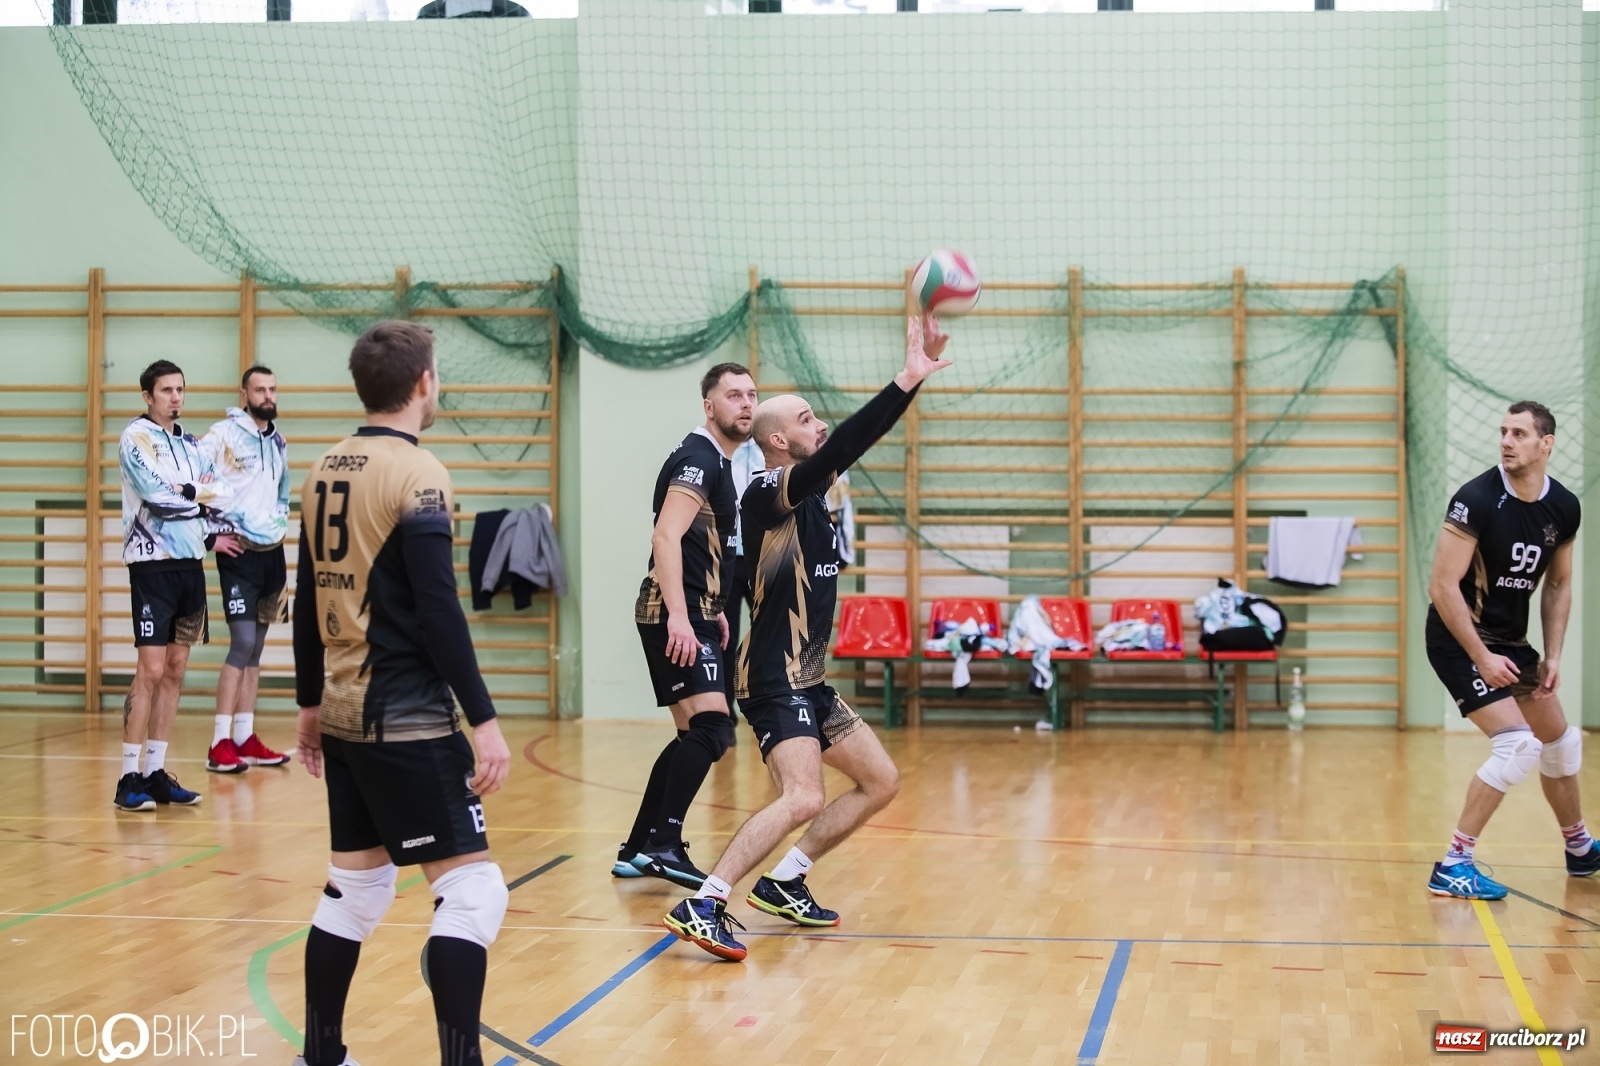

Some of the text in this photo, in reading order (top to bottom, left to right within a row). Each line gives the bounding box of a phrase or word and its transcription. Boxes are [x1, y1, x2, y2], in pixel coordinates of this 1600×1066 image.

[320, 455, 369, 472] TAPPER
[314, 480, 350, 563] 13
[136, 542, 155, 556] 19
[1510, 542, 1542, 573] 99
[228, 599, 246, 615] 95
[140, 621, 154, 637] 19
[702, 663, 718, 681] 17
[798, 708, 811, 726] 4
[468, 804, 486, 833] 13
